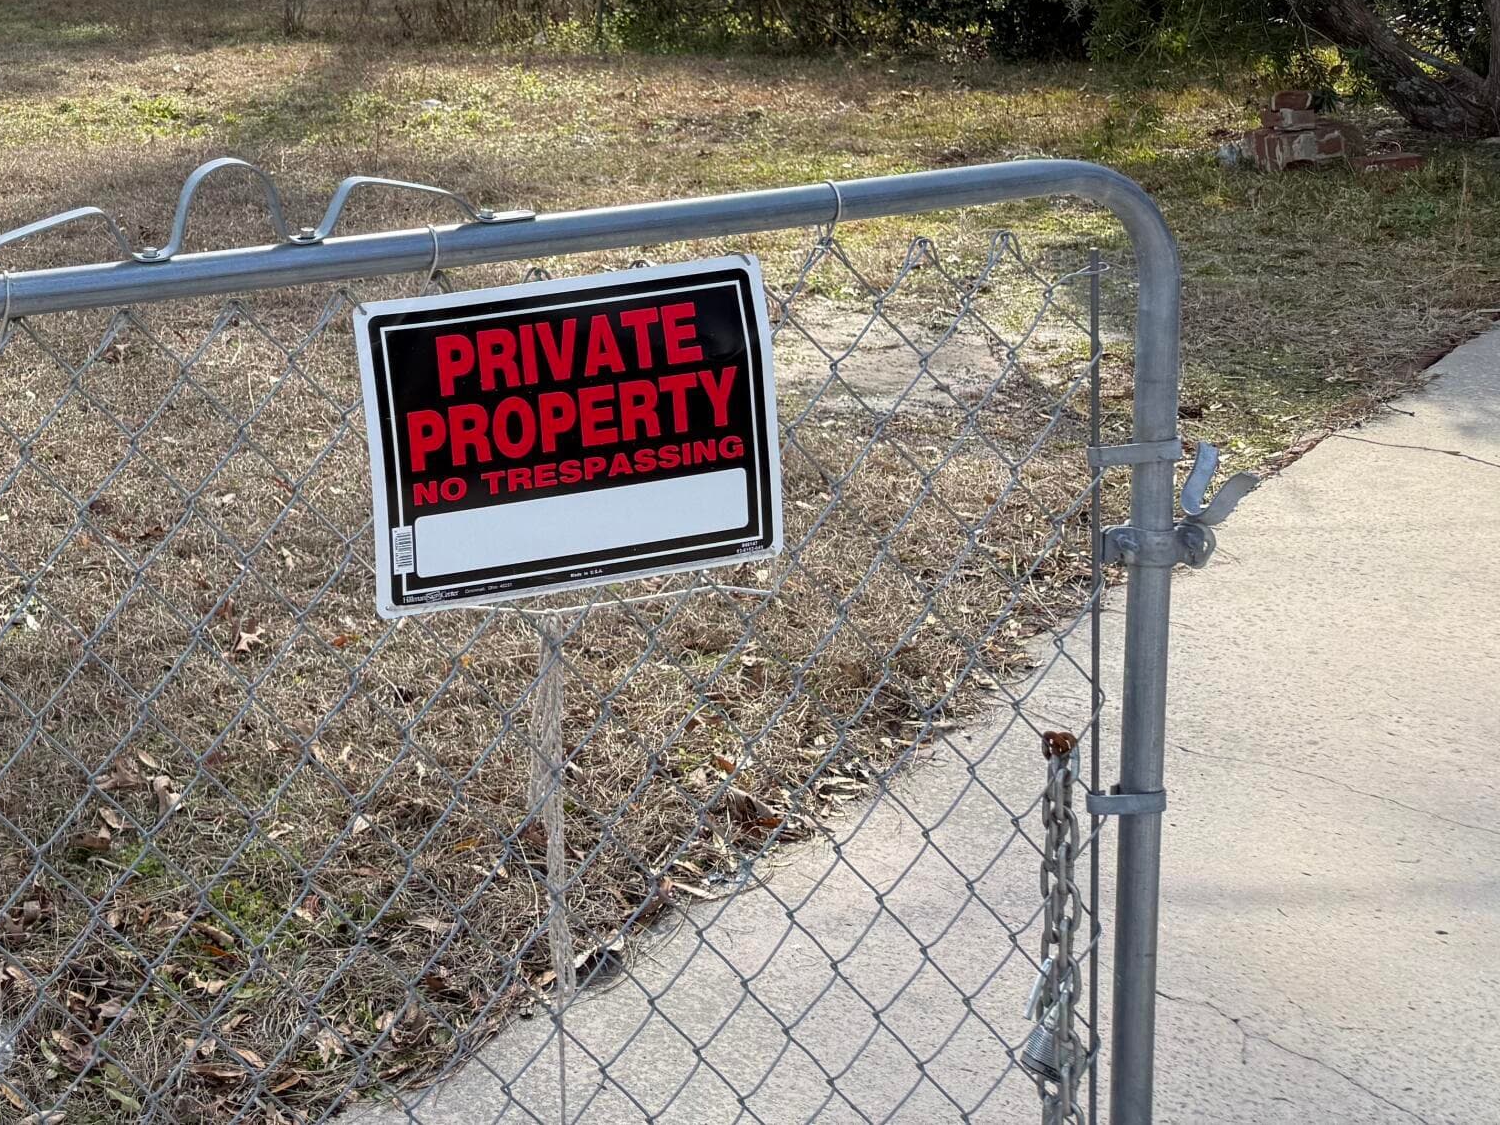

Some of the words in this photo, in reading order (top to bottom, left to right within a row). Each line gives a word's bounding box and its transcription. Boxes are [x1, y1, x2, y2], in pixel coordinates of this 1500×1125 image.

[436, 302, 704, 397] PRIVATE
[407, 366, 738, 472] PROPERTY
[413, 477, 468, 506] NO
[481, 435, 745, 495] TRESPASSING
